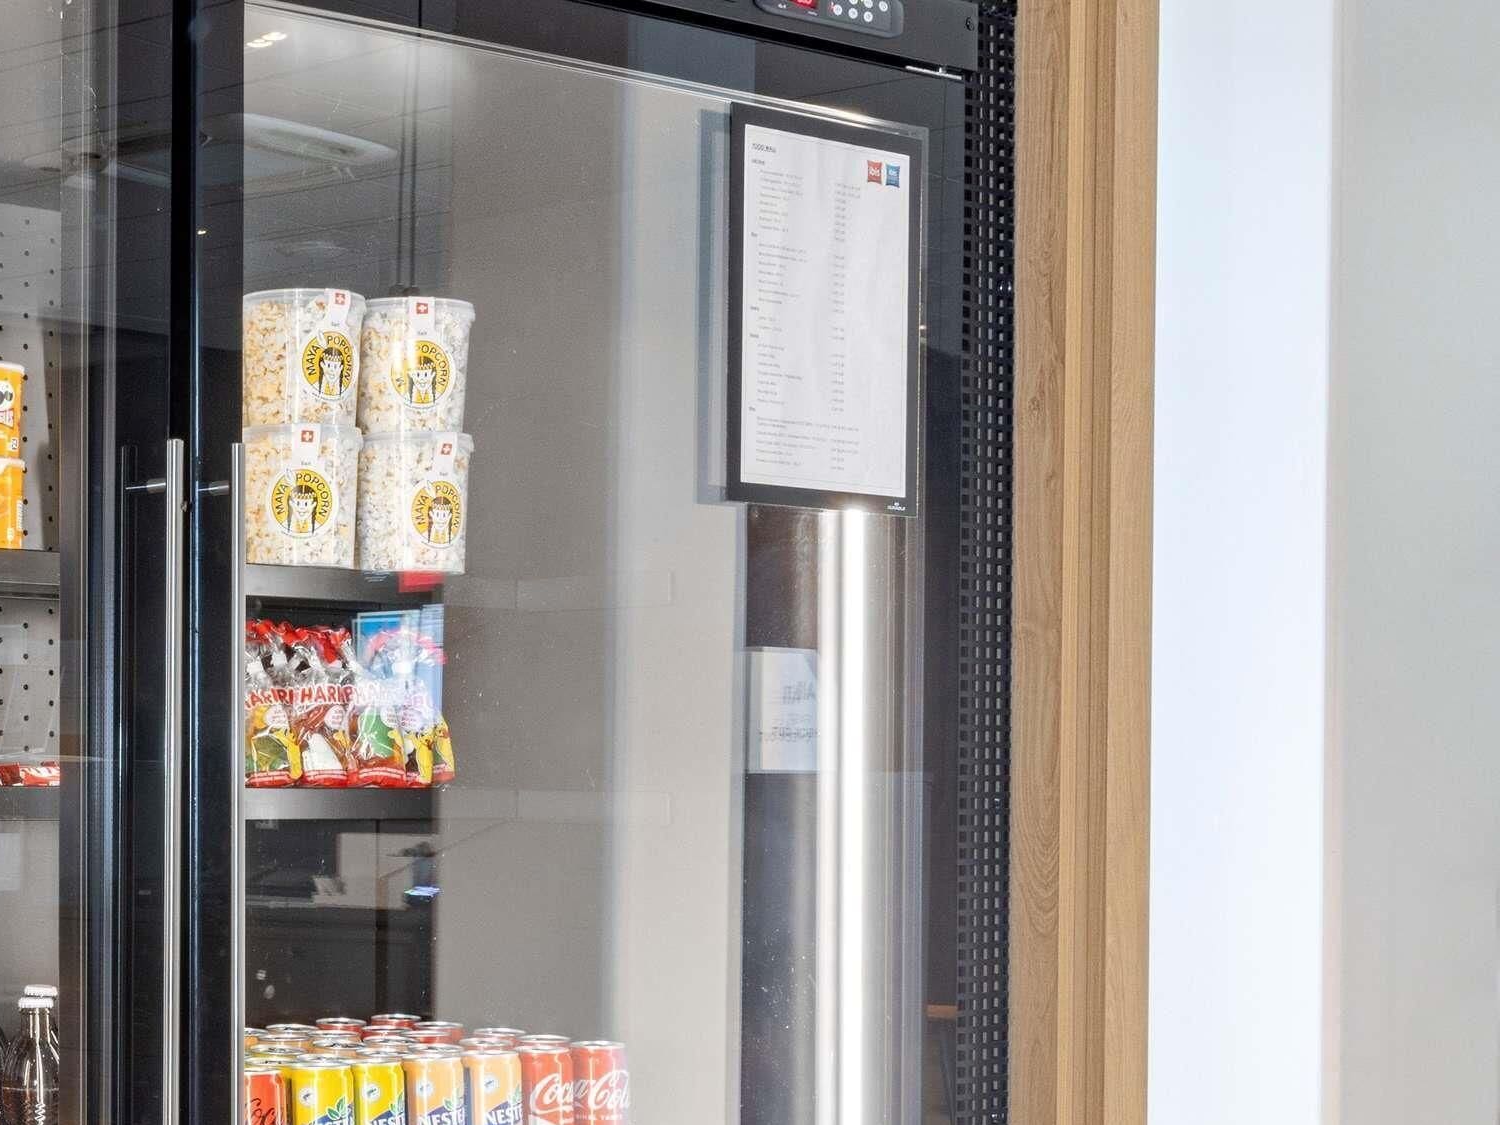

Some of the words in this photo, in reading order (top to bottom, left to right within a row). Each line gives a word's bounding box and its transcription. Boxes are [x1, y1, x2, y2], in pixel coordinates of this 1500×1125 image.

[306, 344, 320, 376] MAYA
[326, 335, 352, 383] POPCORN
[275, 483, 289, 515] MAYA
[296, 473, 330, 518] POPCORN
[415, 494, 429, 526] MAYA
